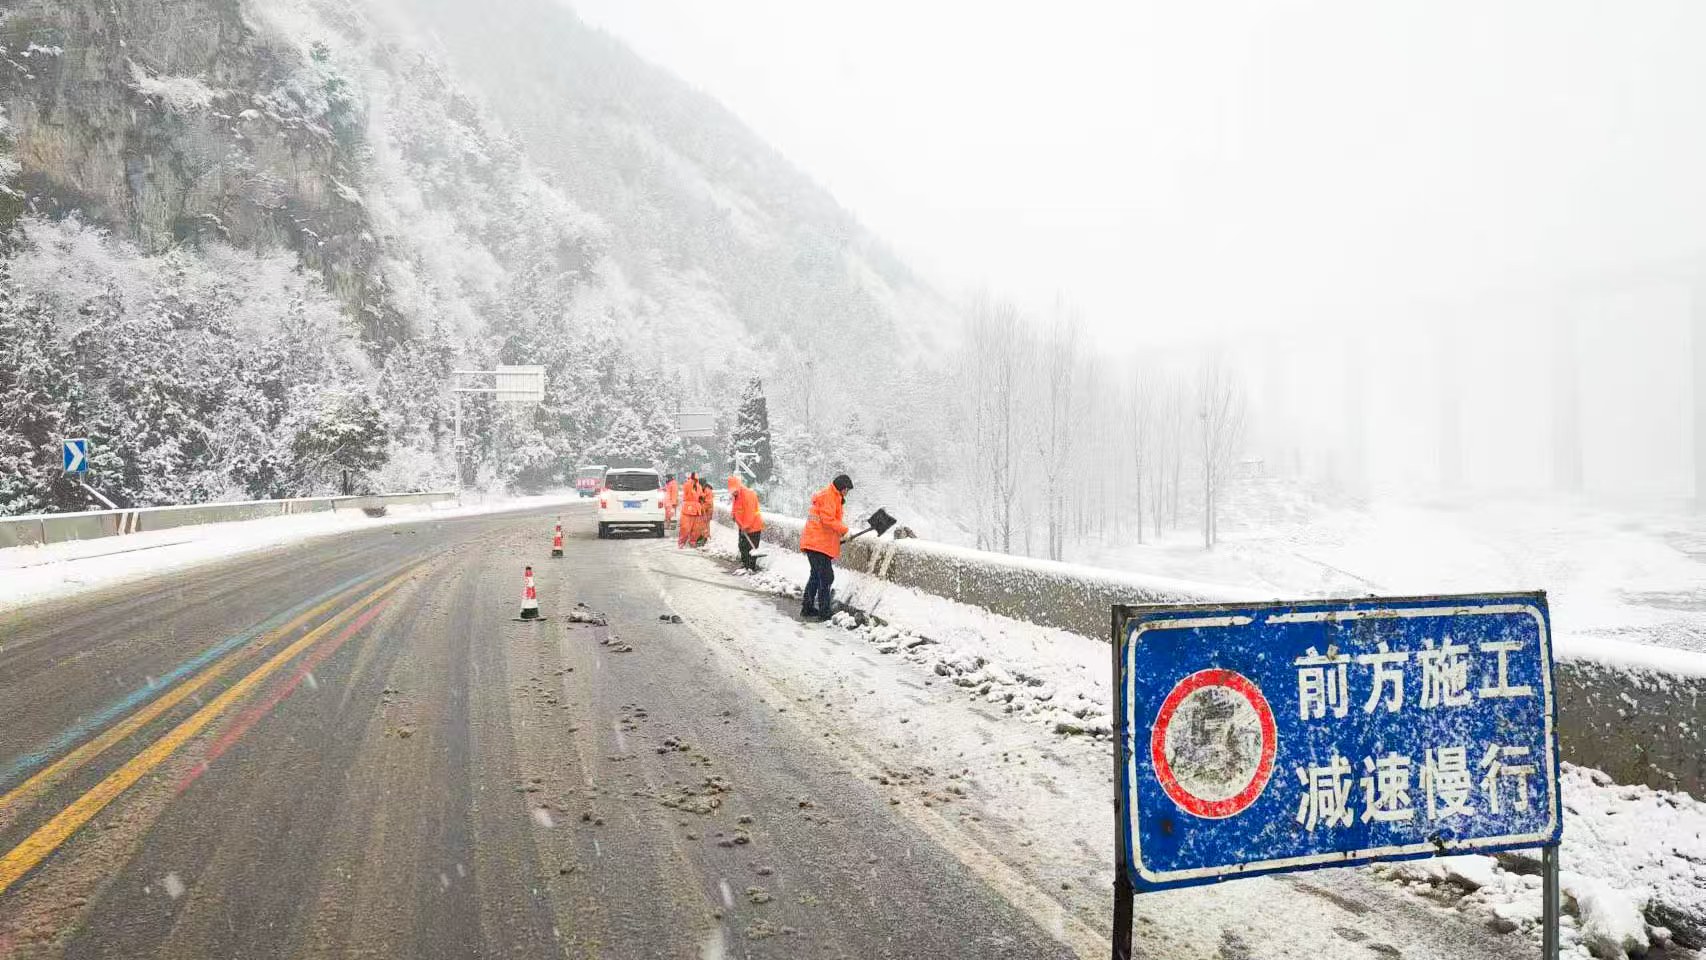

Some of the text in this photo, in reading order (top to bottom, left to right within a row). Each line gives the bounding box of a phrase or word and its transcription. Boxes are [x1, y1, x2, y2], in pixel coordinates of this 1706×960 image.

[1294, 638, 1535, 721] 前方施工
[1295, 742, 1536, 831] 减速慢行
